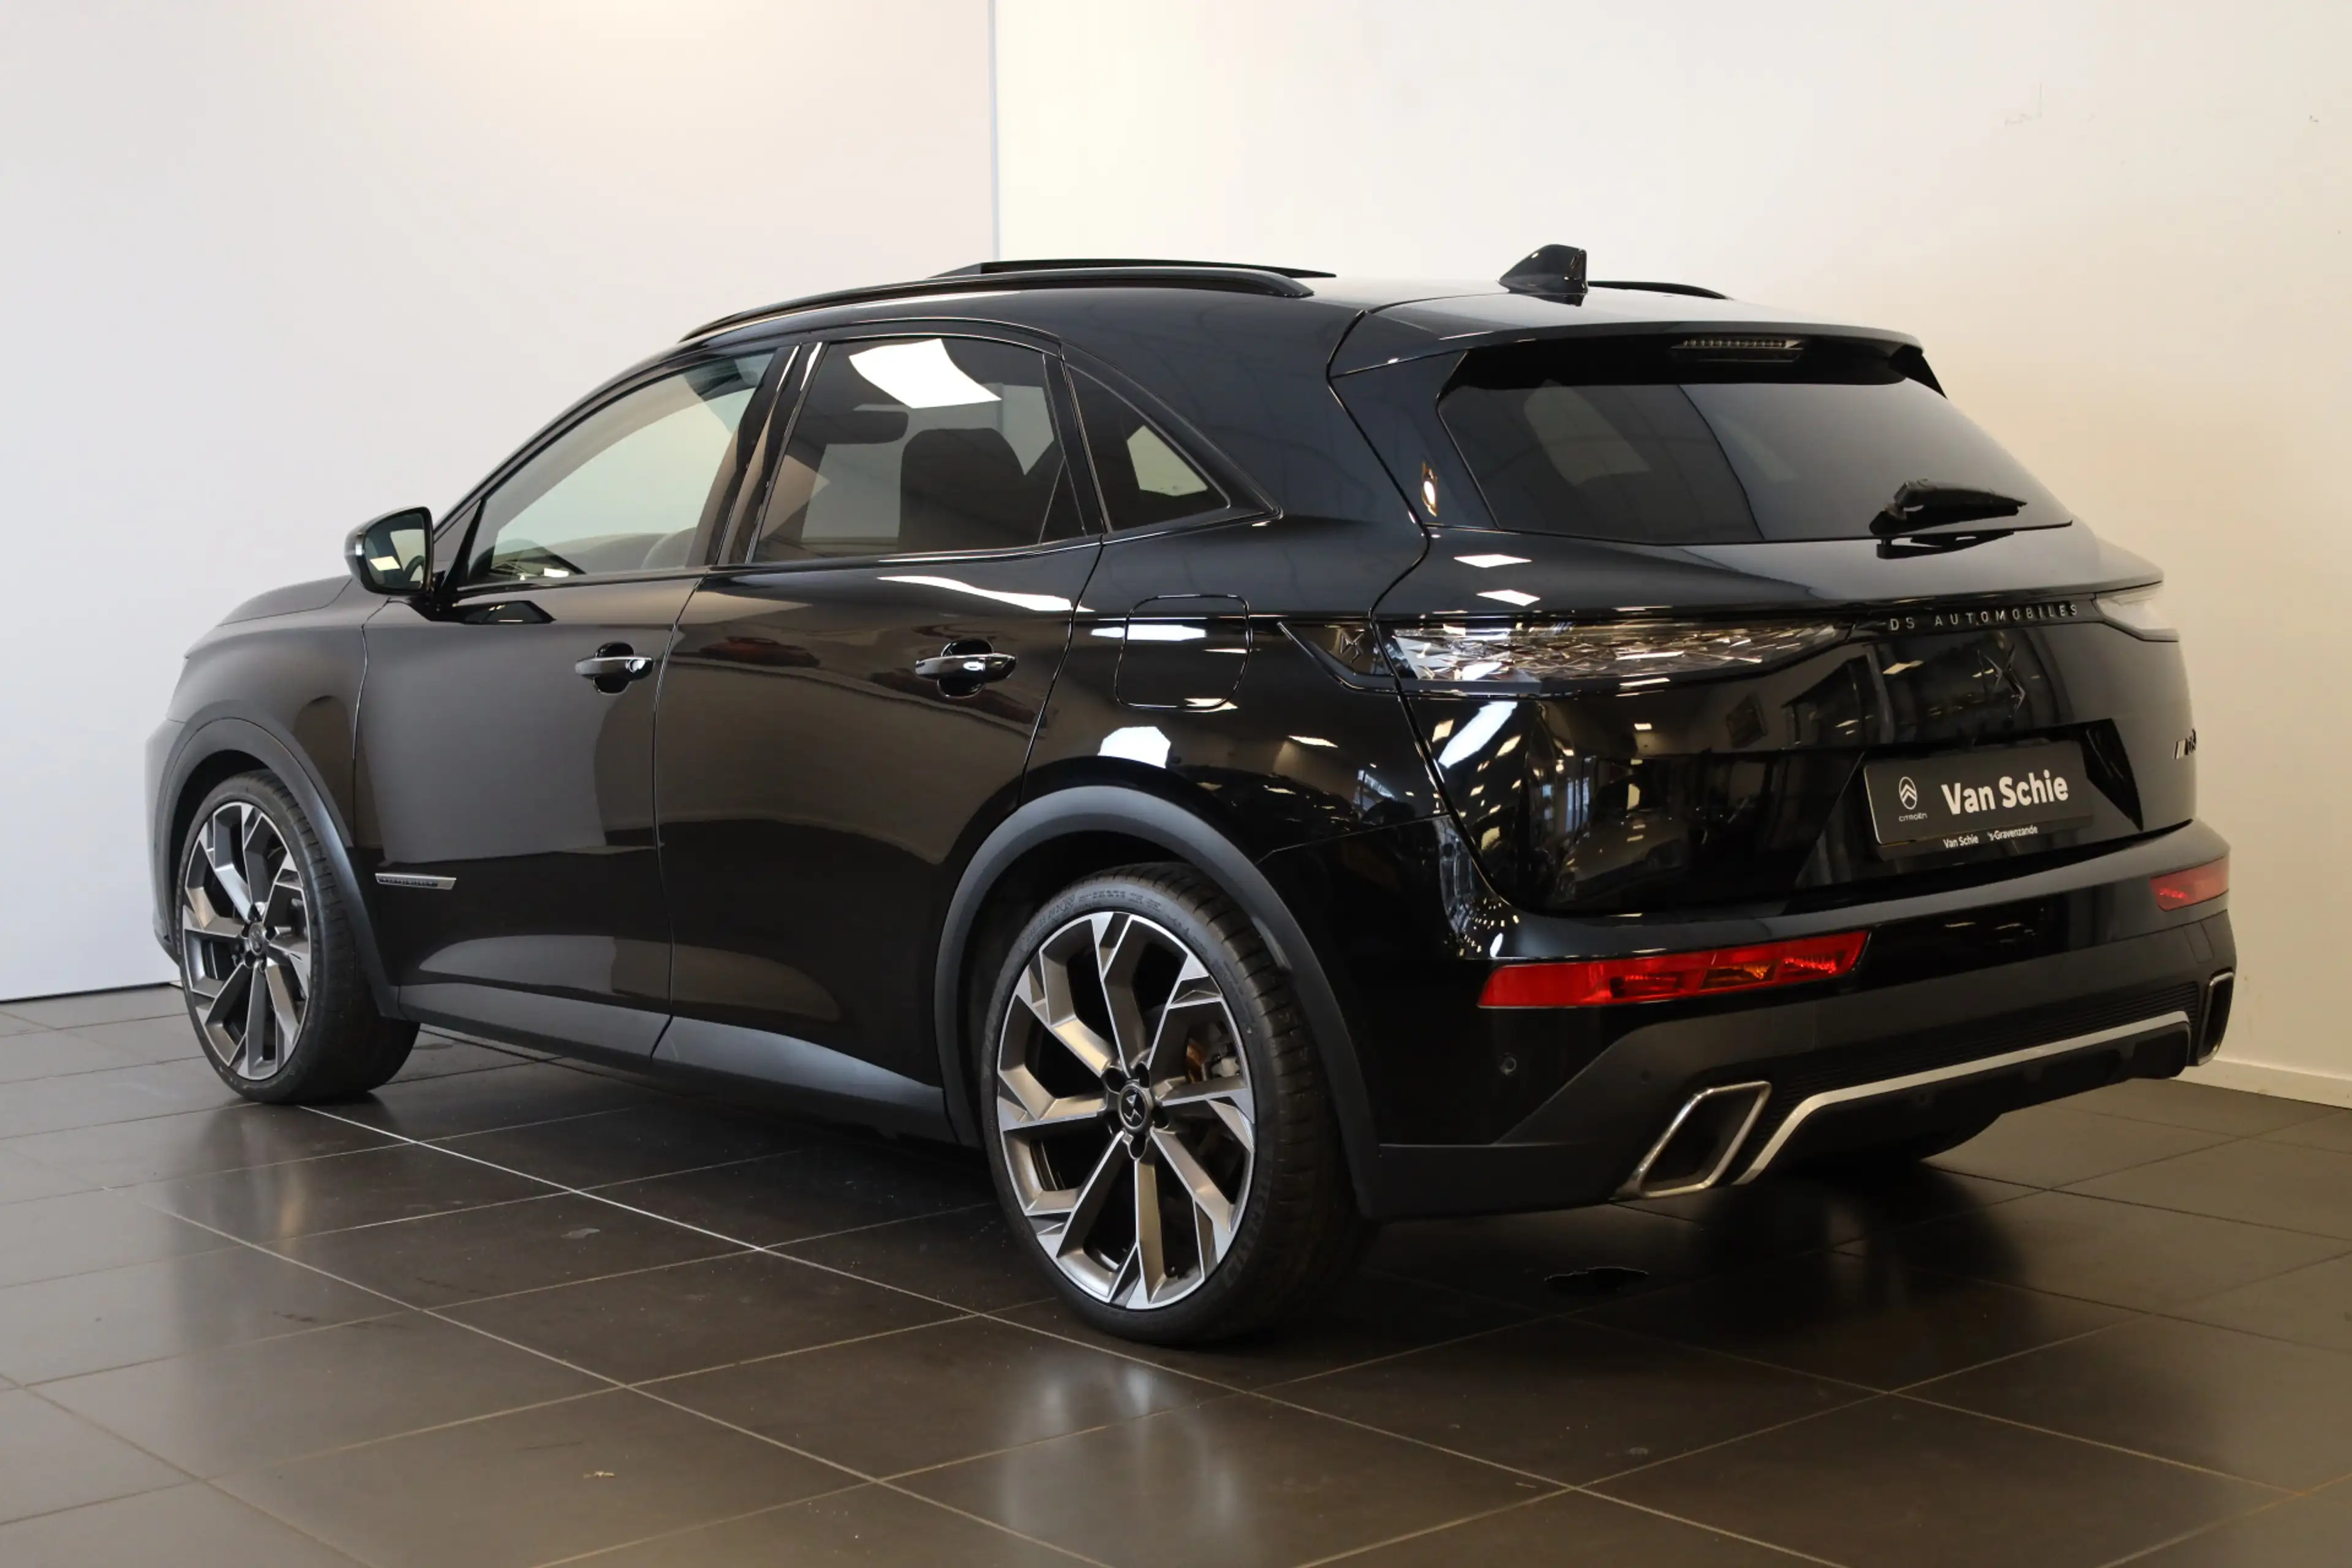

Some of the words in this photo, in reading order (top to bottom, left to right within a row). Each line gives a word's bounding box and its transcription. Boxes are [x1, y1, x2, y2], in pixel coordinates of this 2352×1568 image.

[1890, 616, 1915, 631] DS
[1934, 603, 2078, 627] AUTOMOBILES
[1941, 782, 1996, 815] Van
[1999, 769, 2069, 809] Schie
[1942, 838, 1958, 849] Van
[1959, 834, 1979, 846] Schie
